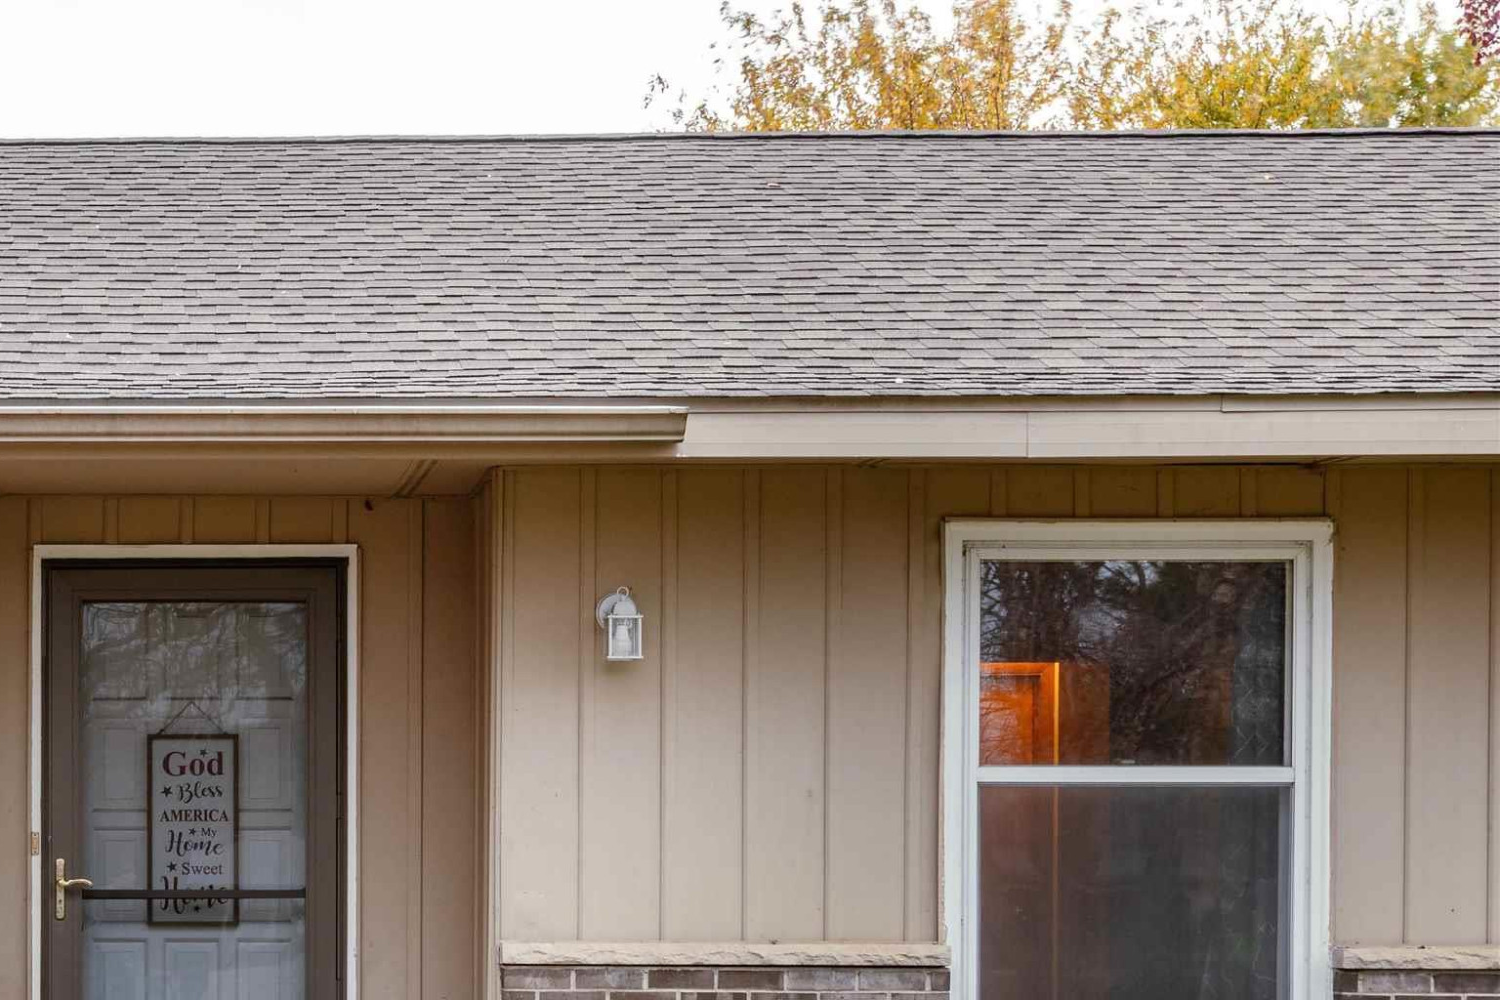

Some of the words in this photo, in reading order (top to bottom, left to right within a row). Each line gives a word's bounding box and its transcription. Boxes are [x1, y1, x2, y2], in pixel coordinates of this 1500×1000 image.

[162, 751, 224, 776] God
[178, 781, 223, 804] Bless
[160, 809, 228, 822] AMERICA
[201, 827, 217, 838] My
[165, 829, 224, 857] Home
[181, 862, 222, 875] Sweet
